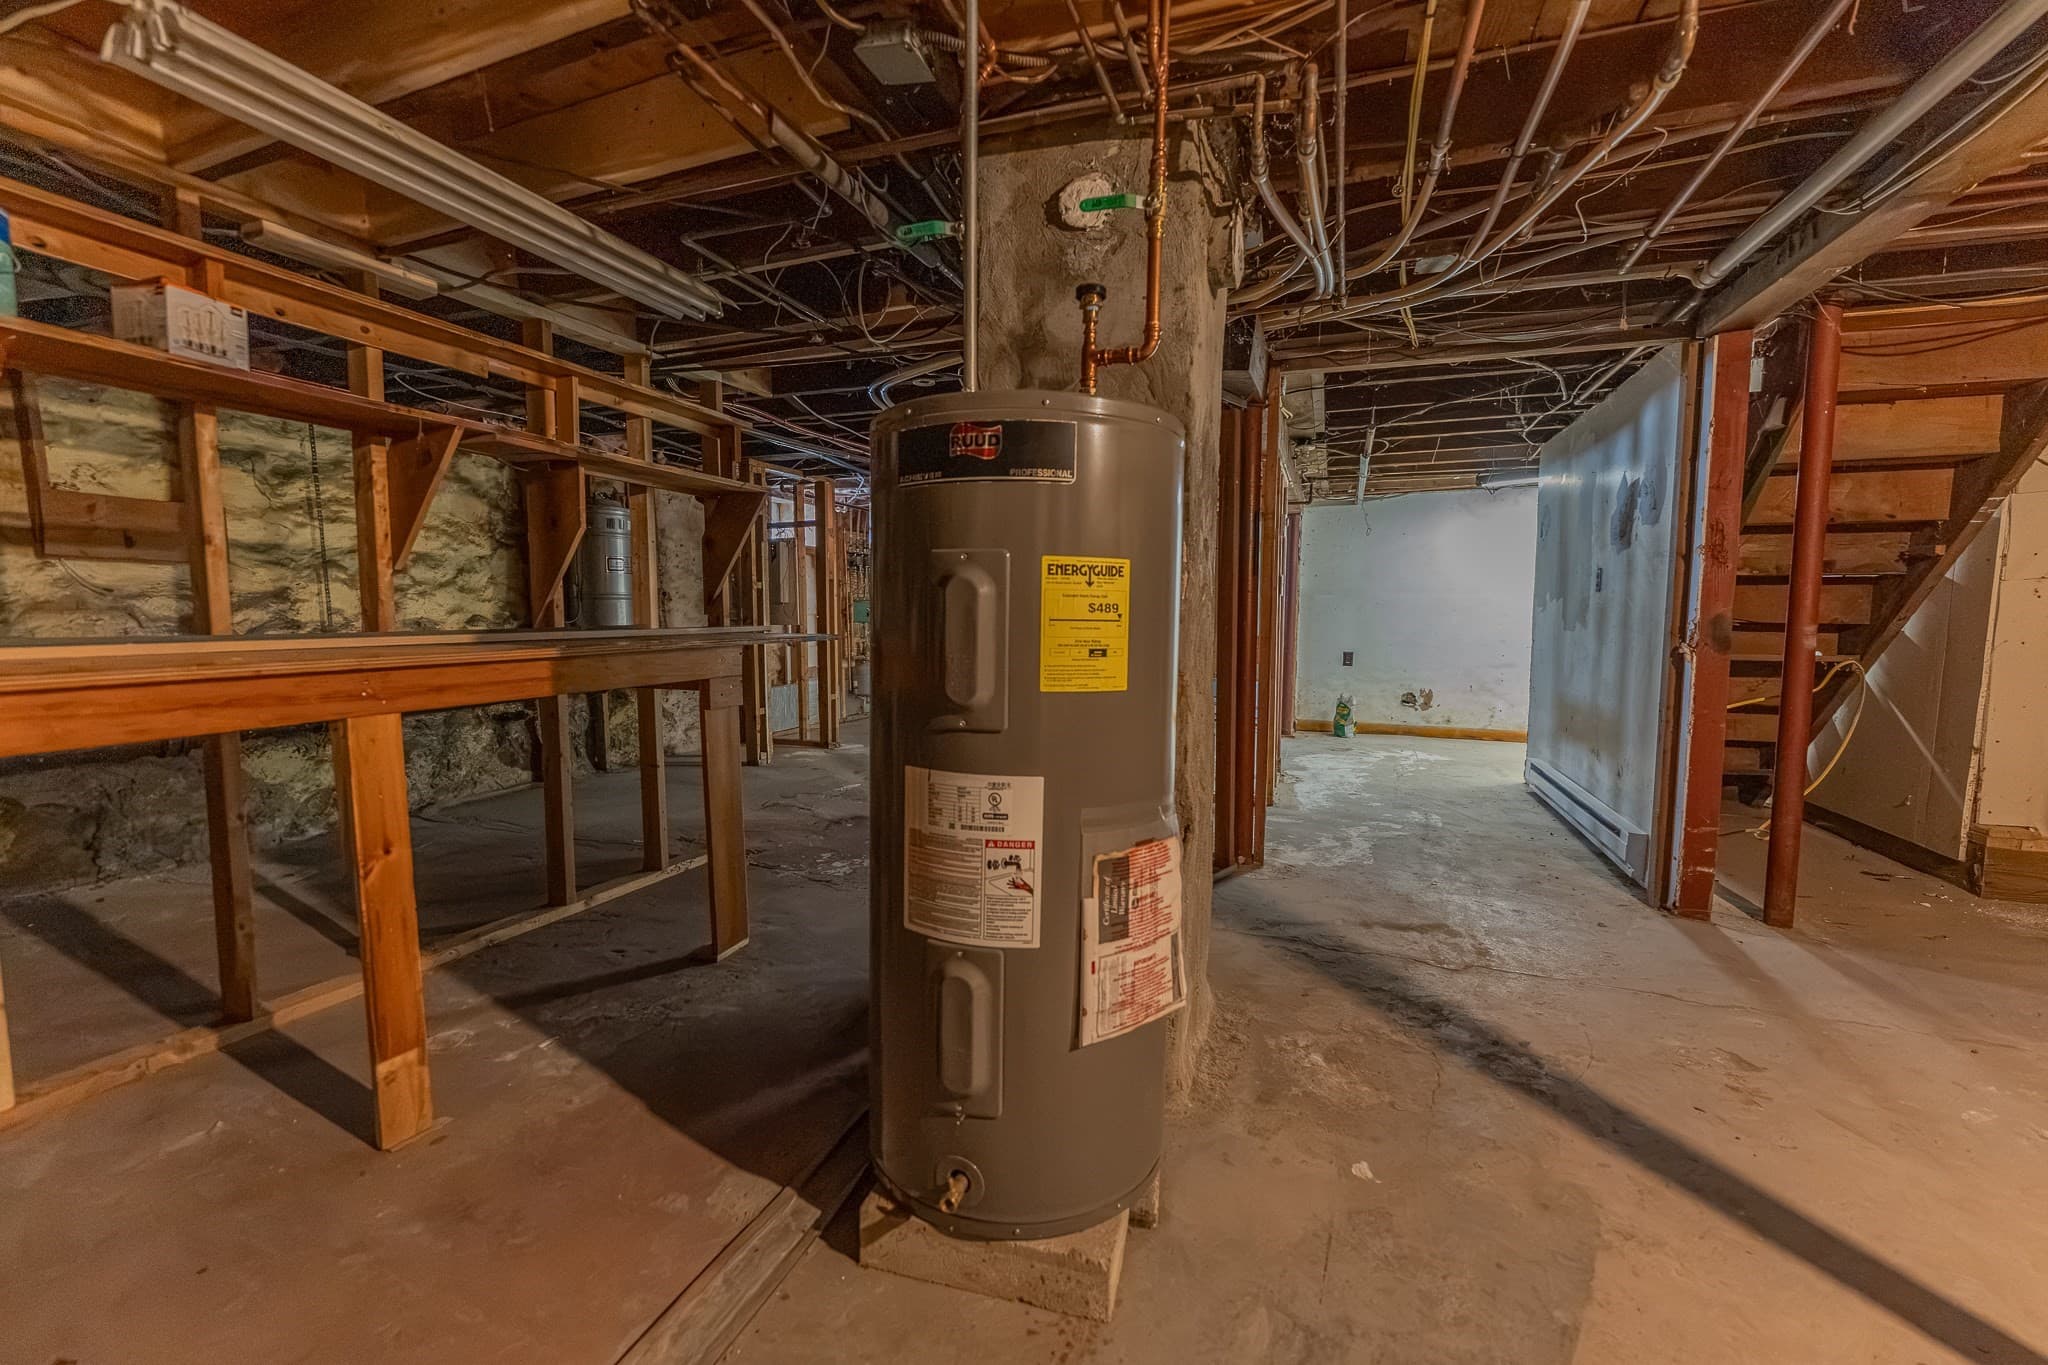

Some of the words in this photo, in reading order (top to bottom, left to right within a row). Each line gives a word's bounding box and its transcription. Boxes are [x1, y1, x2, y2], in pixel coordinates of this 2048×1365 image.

[951, 434, 1000, 448] RUUD
[1010, 468, 1073, 478] PROFESSIONAL
[1048, 564, 1124, 578] ENERGYGUIDE
[997, 841, 1032, 849] DANGER
